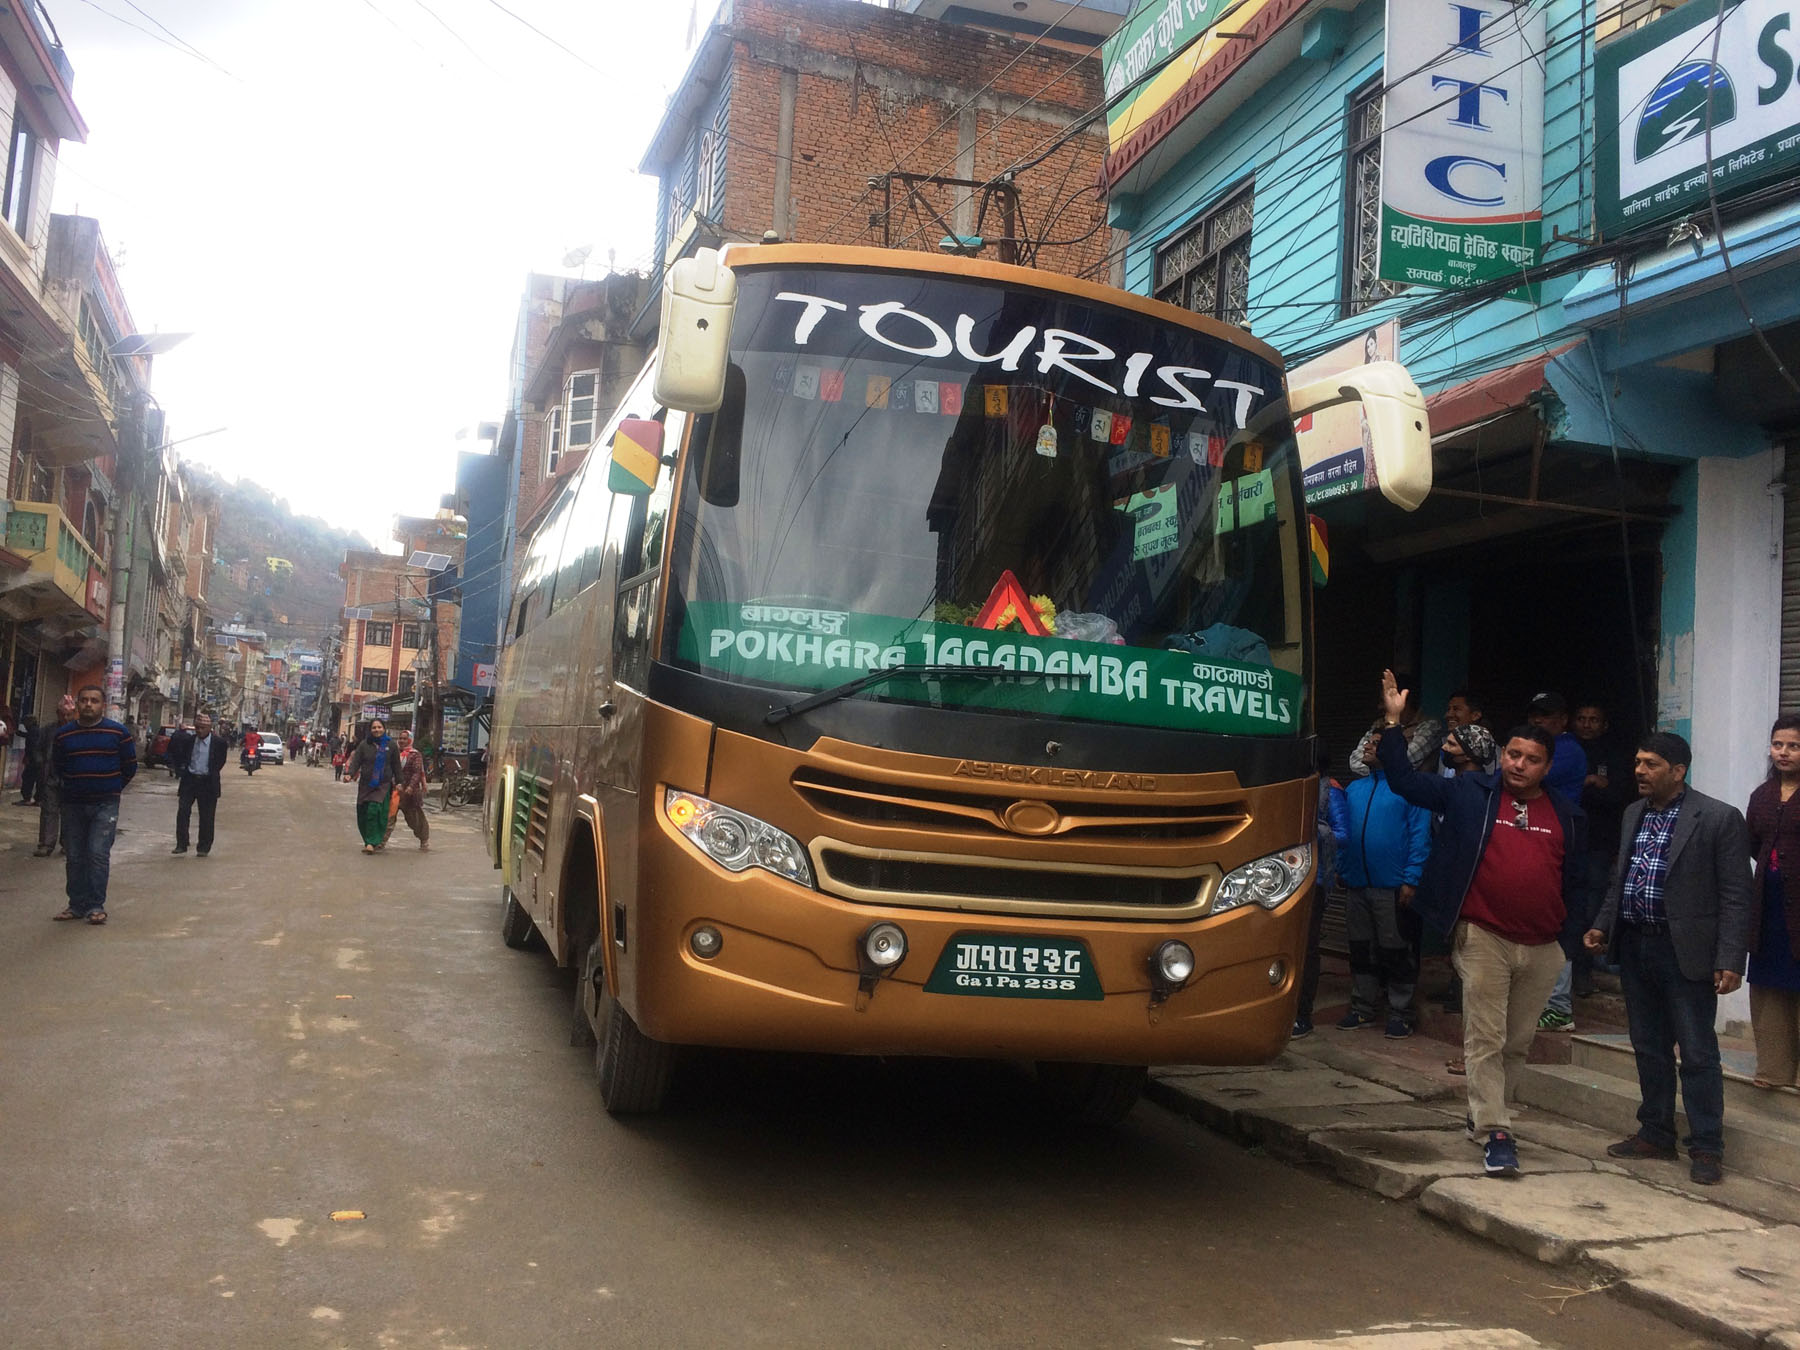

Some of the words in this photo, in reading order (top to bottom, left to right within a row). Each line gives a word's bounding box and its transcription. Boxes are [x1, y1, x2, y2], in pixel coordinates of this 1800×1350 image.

[1757, 12, 1800, 106] S
[1622, 196, 1651, 216] सानिमा
[775, 292, 1265, 430] TOURIST
[709, 628, 906, 671] POKHARA
[1160, 678, 1291, 724] TRAVELS
[953, 760, 1042, 784] ASHOK
[1048, 769, 1158, 791] LEYLAND
[1024, 978, 1076, 990] 238
